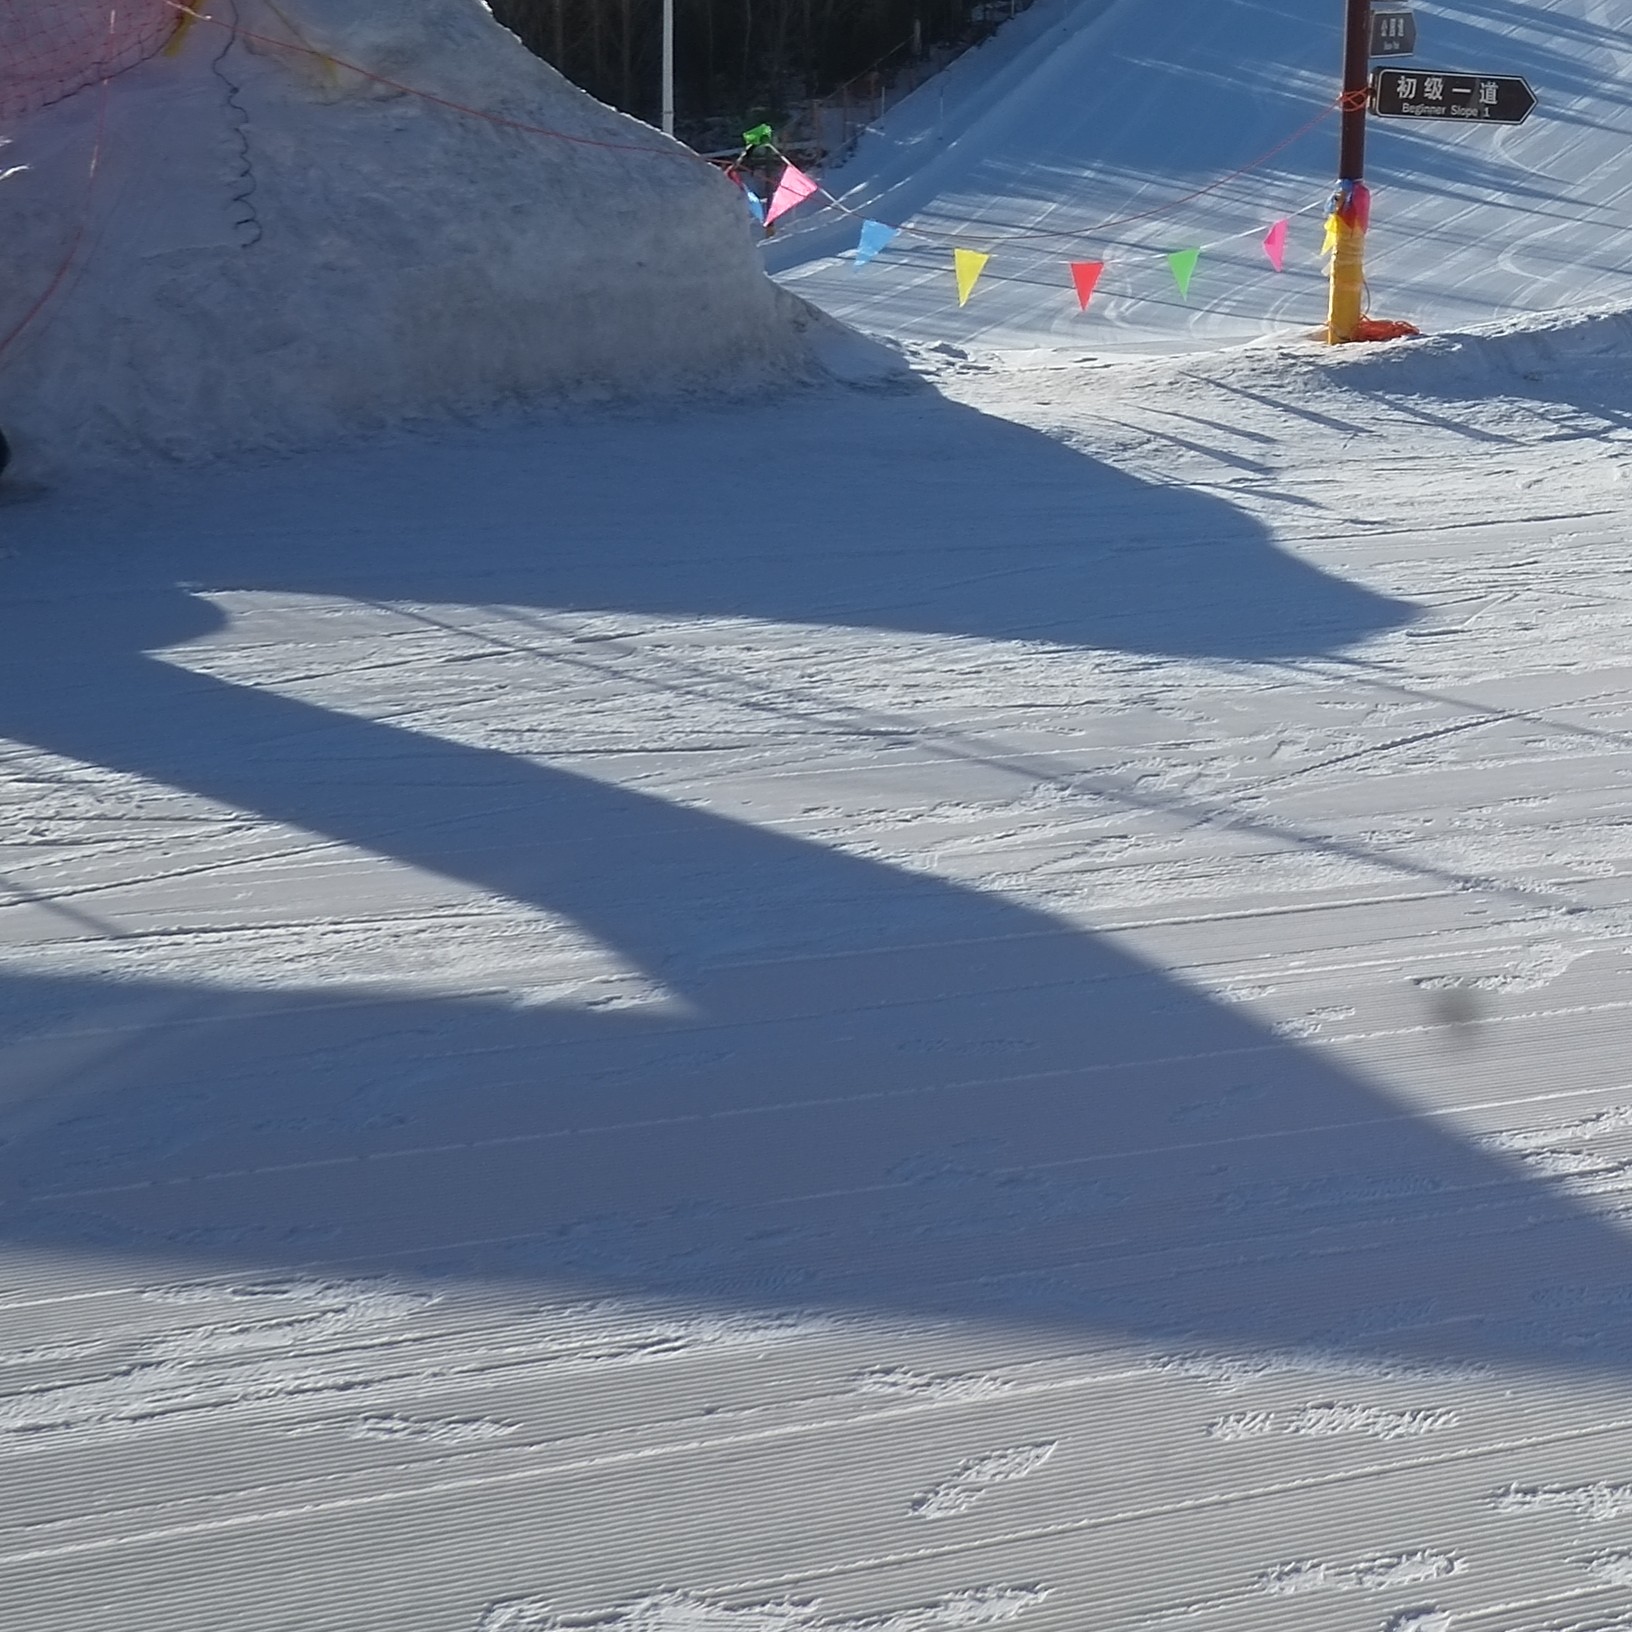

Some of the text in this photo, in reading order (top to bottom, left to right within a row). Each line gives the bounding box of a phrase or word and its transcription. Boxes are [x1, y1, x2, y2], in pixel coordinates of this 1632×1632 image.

[1397, 75, 1499, 105] 初级一道
[1402, 102, 1491, 118] Beginner Slope 1
